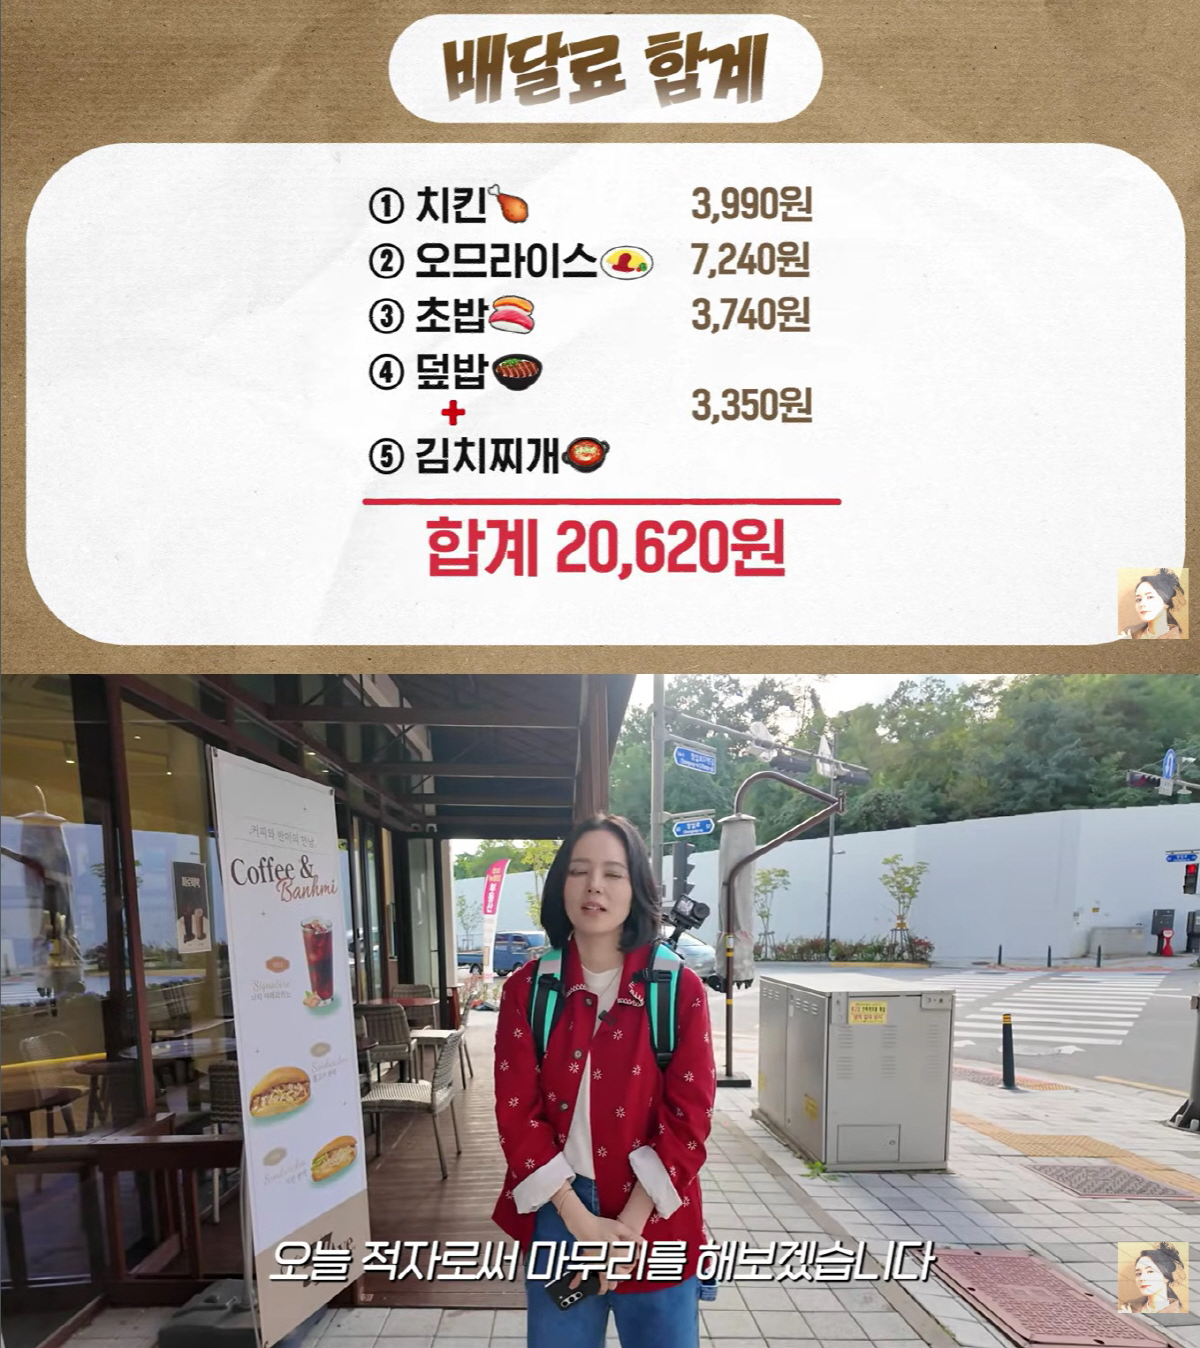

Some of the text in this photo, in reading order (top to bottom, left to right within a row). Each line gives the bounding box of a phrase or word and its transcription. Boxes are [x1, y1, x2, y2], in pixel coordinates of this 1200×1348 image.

[231, 856, 295, 886] Coffee
[300, 854, 315, 879] &
[276, 875, 338, 902] Banhmi
